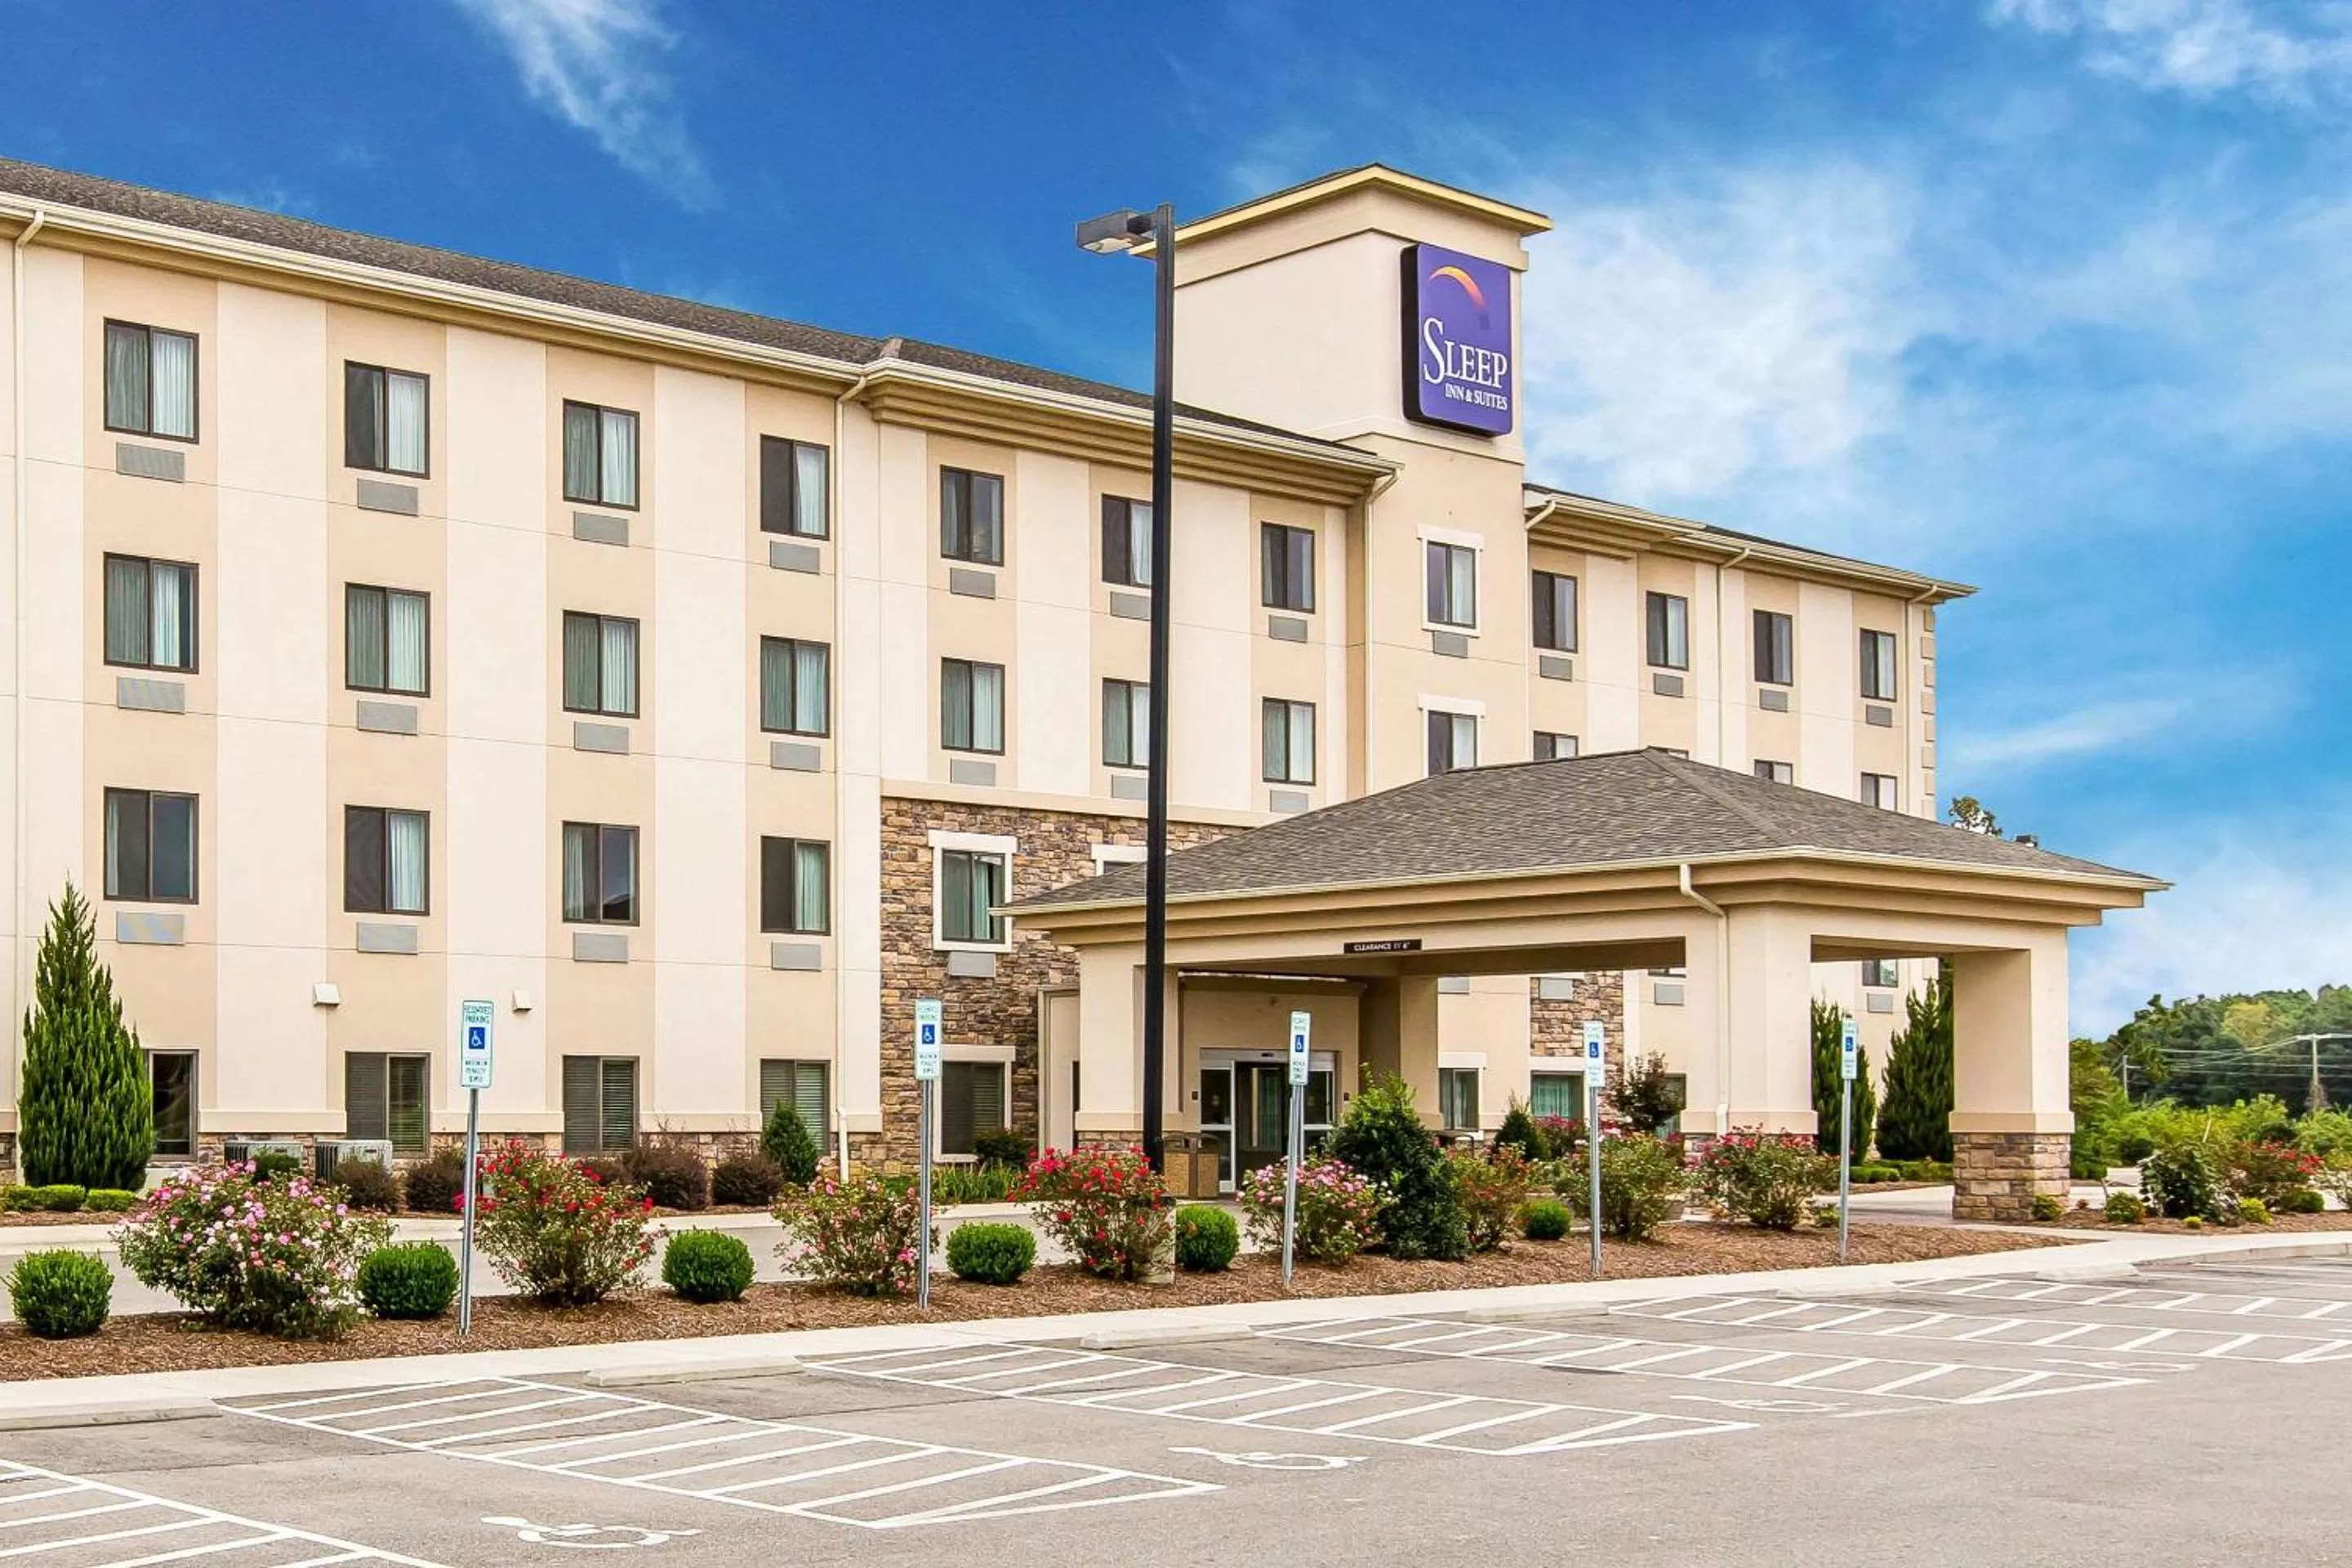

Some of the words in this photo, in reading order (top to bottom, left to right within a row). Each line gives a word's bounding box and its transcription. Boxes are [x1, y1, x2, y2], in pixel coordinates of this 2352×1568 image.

[1445, 383, 1465, 402] INN
[1465, 388, 1473, 403] &
[1474, 390, 1508, 411] SUITES
[1353, 942, 1392, 951] CLEARANCE
